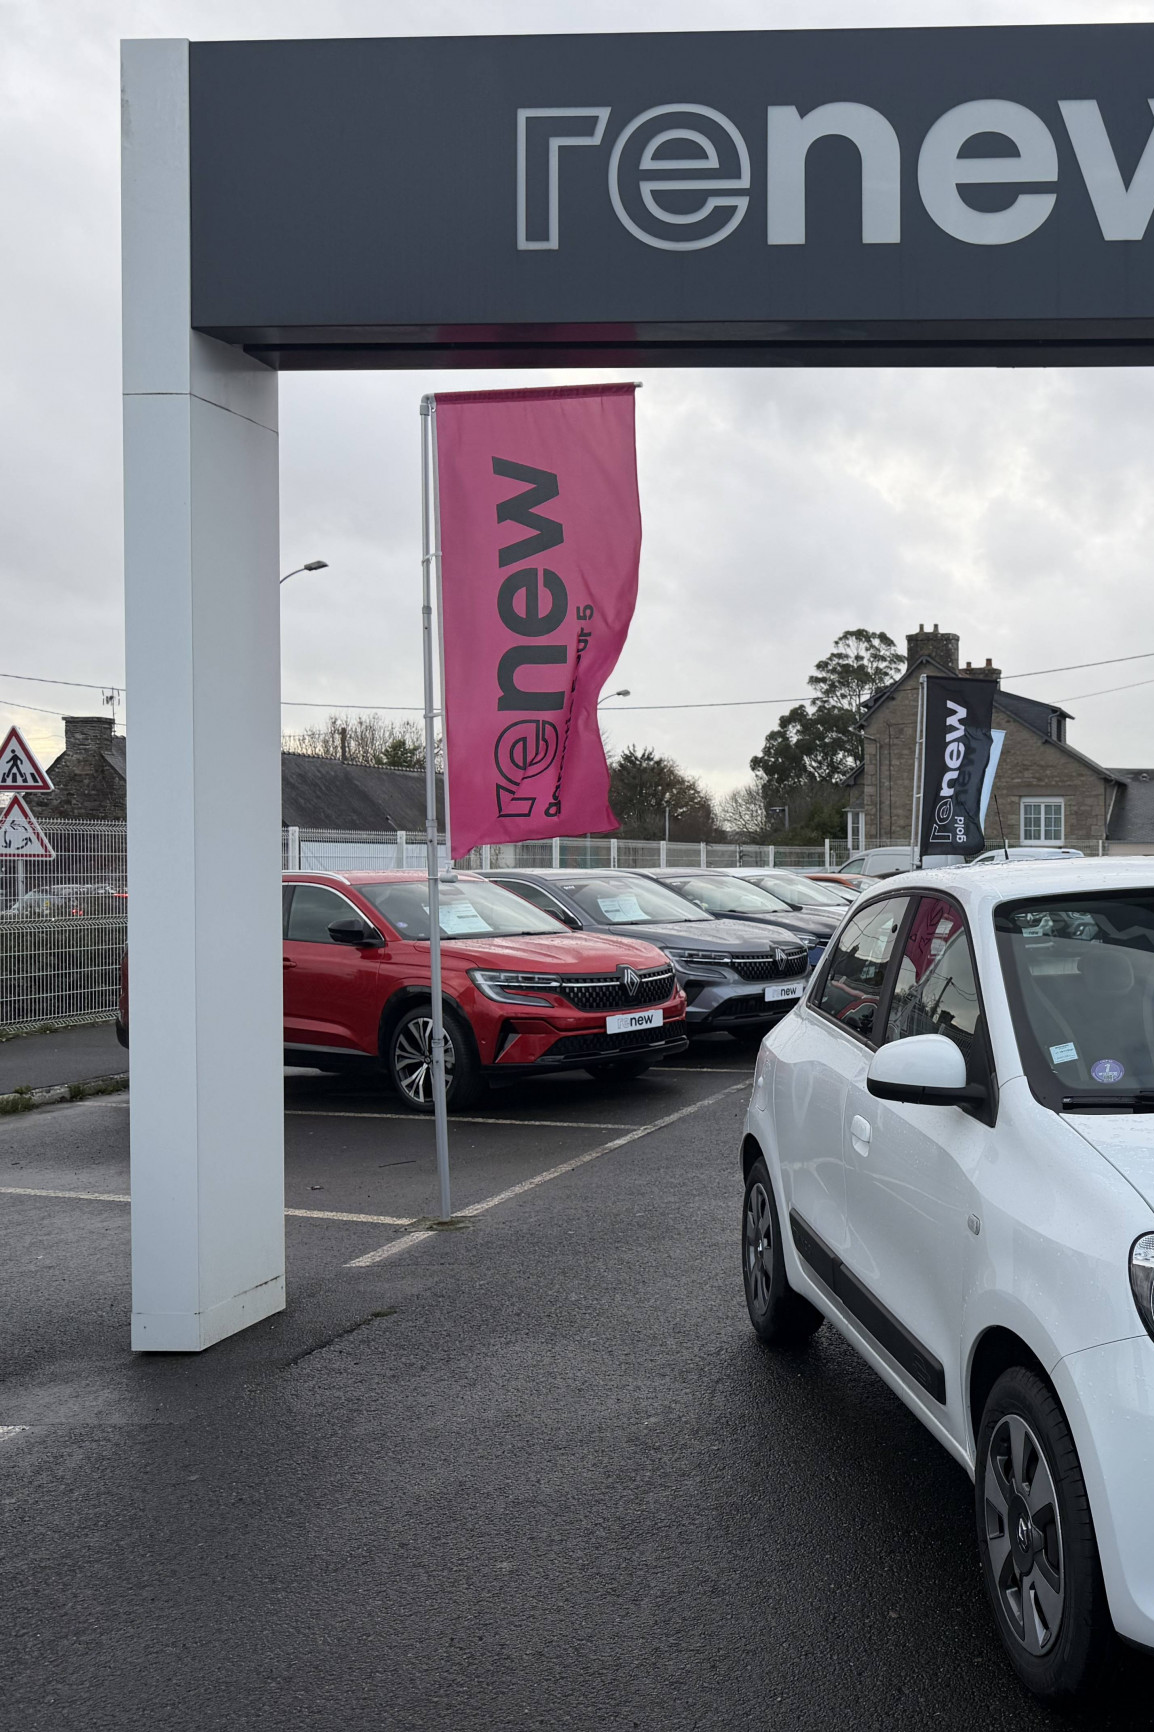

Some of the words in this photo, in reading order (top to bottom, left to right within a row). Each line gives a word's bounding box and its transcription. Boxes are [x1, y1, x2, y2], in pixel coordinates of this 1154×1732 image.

[576, 603, 594, 621] 5
[492, 456, 569, 818] renew
[929, 699, 968, 843] renew
[954, 816, 967, 843] gold
[617, 1012, 654, 1030] renew
